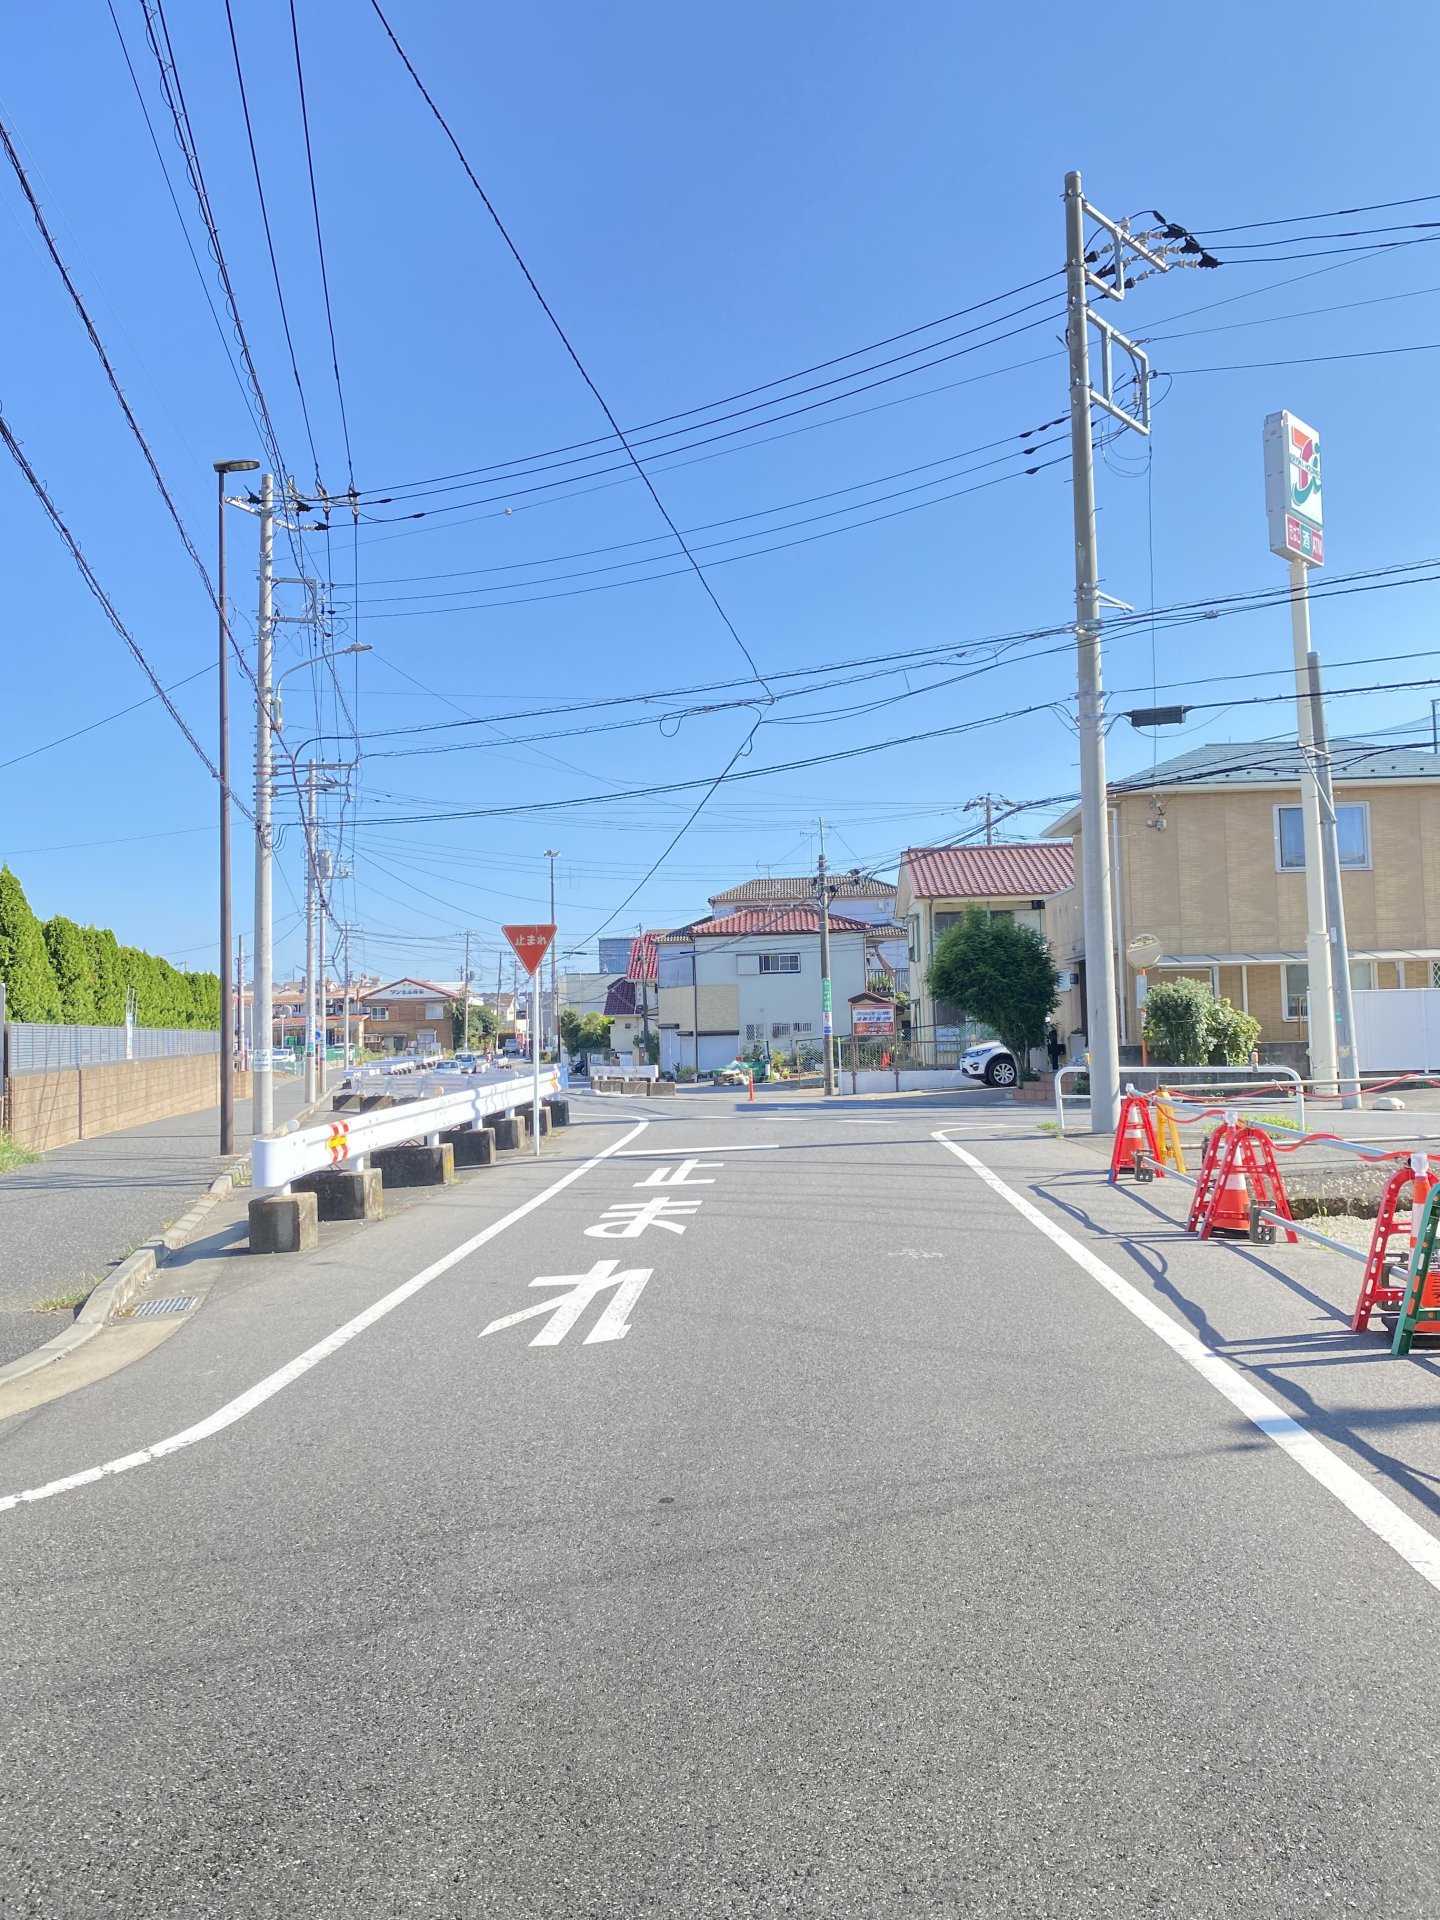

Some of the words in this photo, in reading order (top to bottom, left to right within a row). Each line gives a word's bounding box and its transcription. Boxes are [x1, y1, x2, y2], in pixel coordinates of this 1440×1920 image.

[514, 934, 547, 946] 止まれ
[477, 1158, 725, 1347] 止まれ
